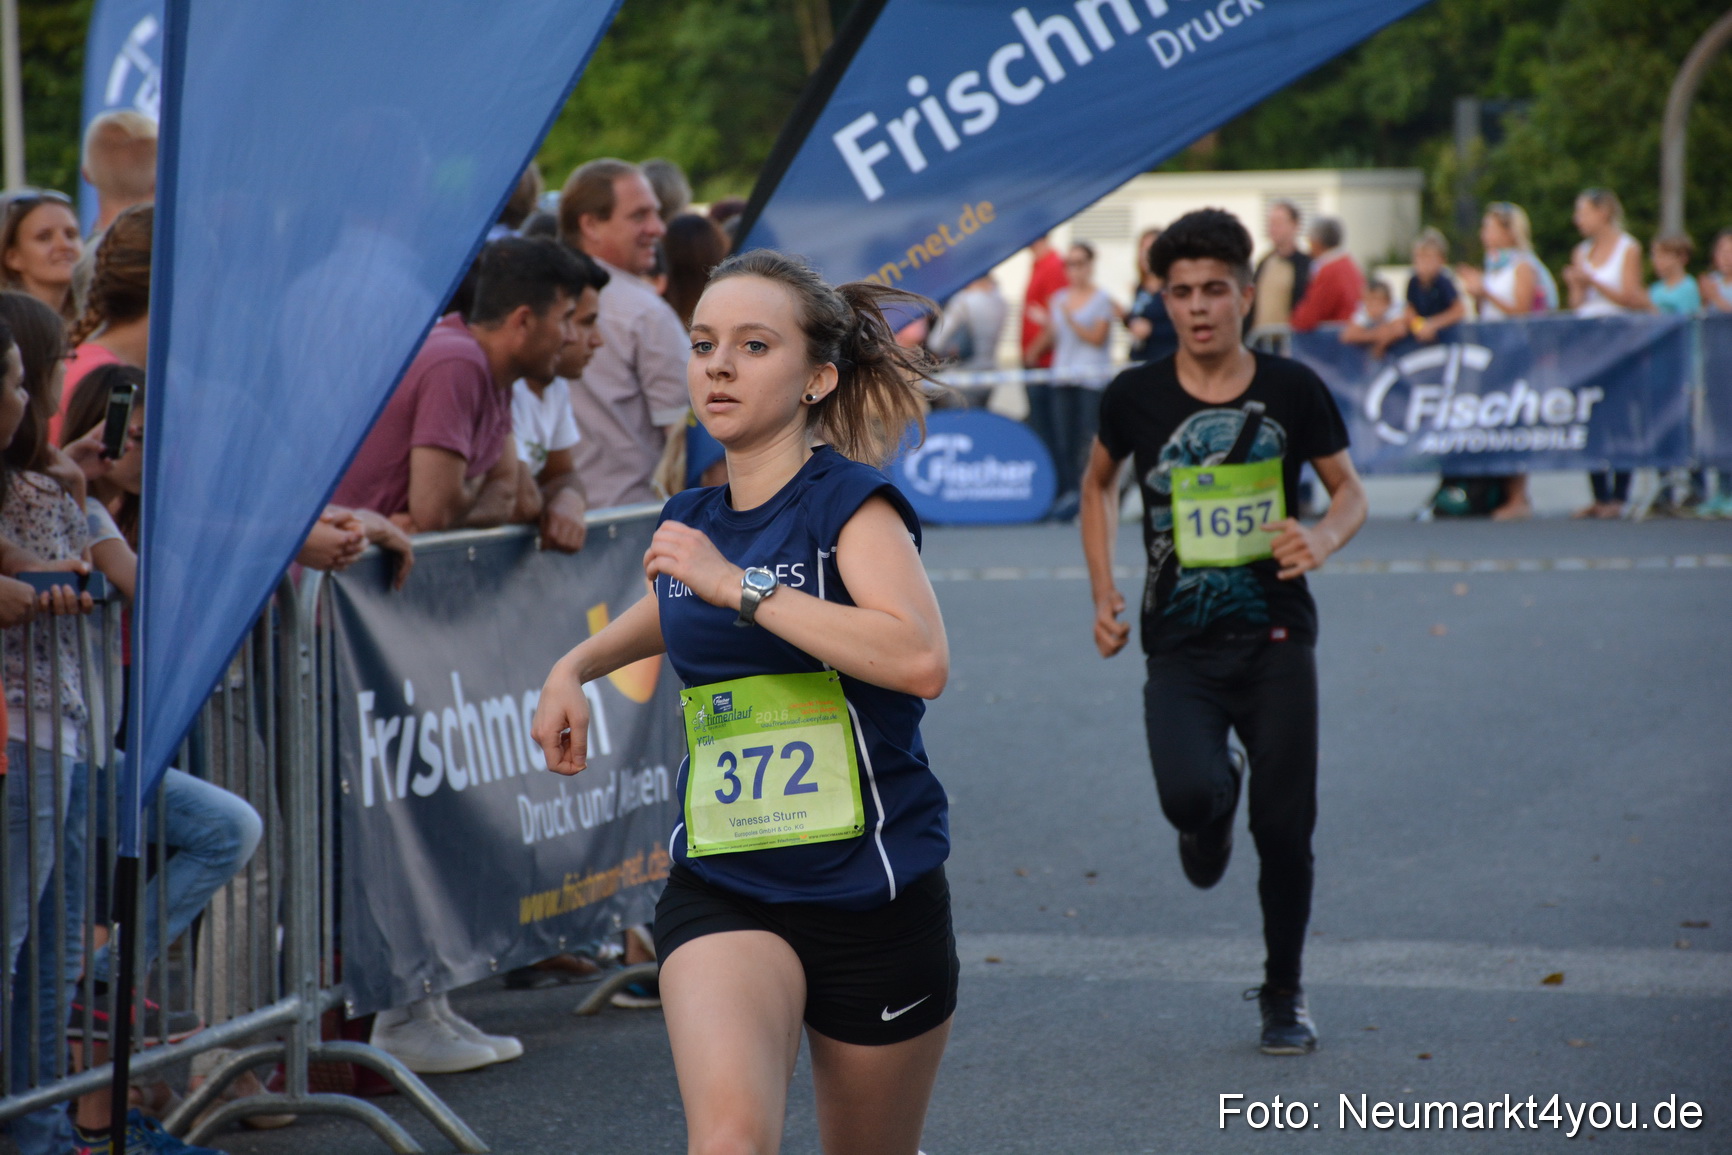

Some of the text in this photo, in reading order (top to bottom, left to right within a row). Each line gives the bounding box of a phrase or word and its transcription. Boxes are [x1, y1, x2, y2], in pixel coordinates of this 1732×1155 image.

[832, 0, 1190, 202] Frischm
[1405, 378, 1604, 433] Fischer
[1419, 423, 1588, 453] AUTOMOBILE
[1187, 500, 1273, 538] 1657
[706, 705, 753, 727] firmenlauf
[755, 708, 789, 724] 2016
[714, 740, 819, 805] 372
[517, 781, 576, 845] Druck
[729, 810, 807, 828] Vanessa Sturm
[734, 830, 758, 839] Europoles
[759, 827, 776, 835] GmbH
[794, 823, 804, 831] KG
